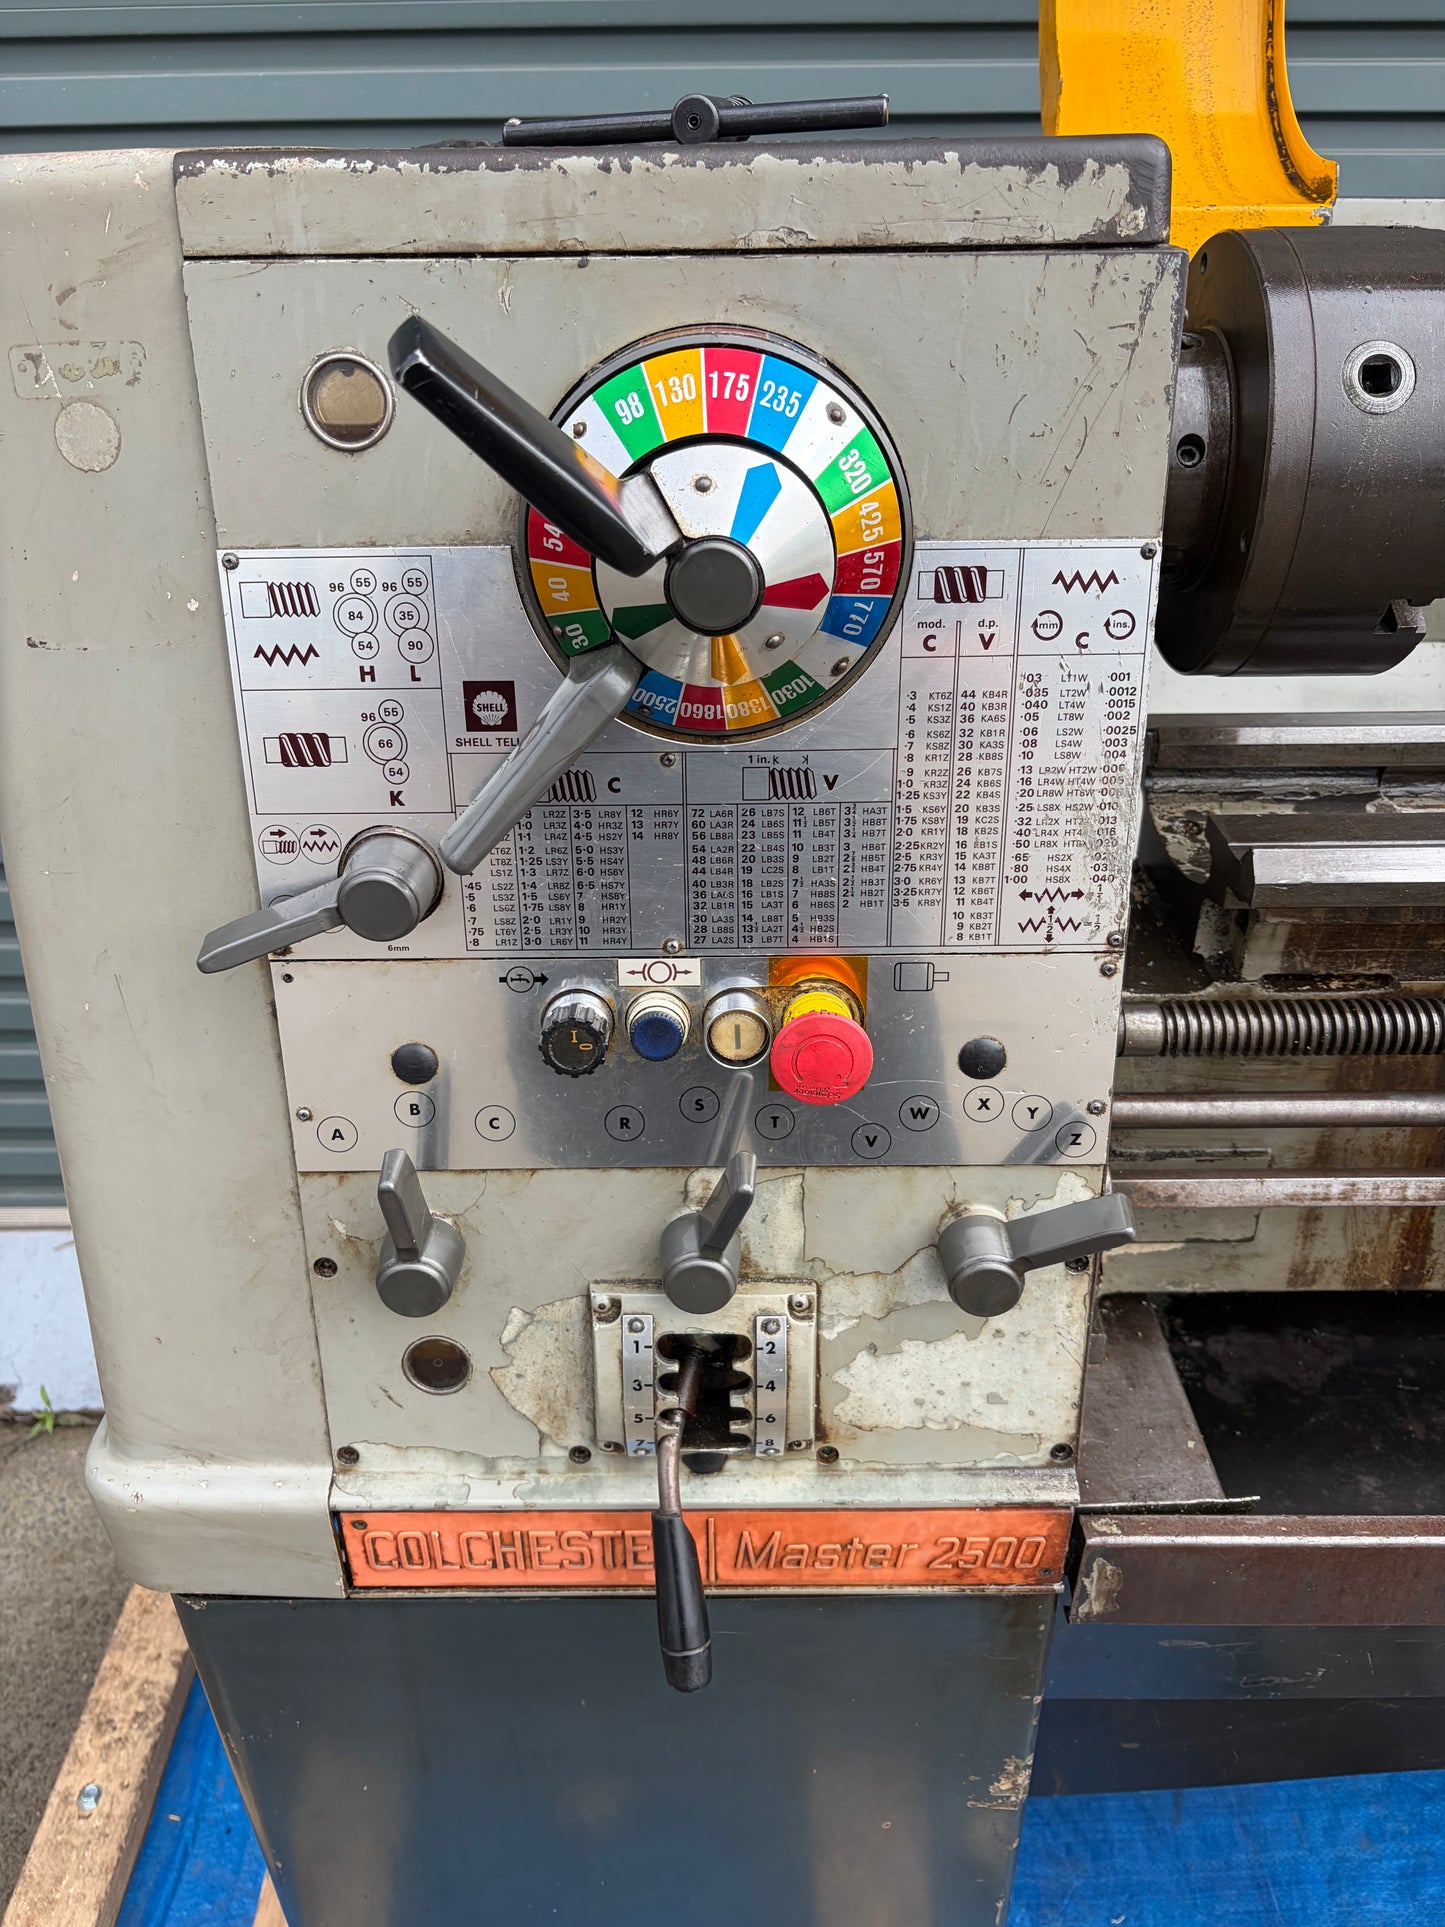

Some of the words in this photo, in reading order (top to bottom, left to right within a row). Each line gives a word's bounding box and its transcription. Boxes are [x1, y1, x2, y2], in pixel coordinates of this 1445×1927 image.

[654, 374, 695, 406] 130
[708, 371, 750, 401] 175
[759, 381, 802, 417] 235
[614, 392, 644, 424] 98
[838, 450, 872, 494] 320
[860, 501, 884, 543] 425
[860, 552, 884, 590] 570
[356, 578, 371, 586] 55
[407, 578, 422, 586] 55
[329, 583, 344, 592] 96
[382, 582, 397, 592] 96
[547, 577, 568, 601] 40
[348, 611, 364, 620] 84
[399, 611, 414, 620] 35
[844, 600, 874, 636] 770
[917, 619, 946, 629] mod.
[978, 619, 999, 629] d.p.
[565, 623, 588, 649] 30
[1076, 632, 1089, 649] C
[358, 641, 373, 650] 54
[408, 641, 423, 650] 90
[923, 634, 936, 651] C
[979, 633, 995, 650] V
[360, 666, 376, 682] H
[411, 666, 421, 682] L
[773, 674, 816, 704] 1030
[961, 690, 976, 699] 44
[982, 691, 1008, 699] KB4R
[632, 689, 677, 711] 2500
[477, 703, 505, 712] SHELL
[681, 700, 723, 720] 1860
[728, 698, 770, 719] 1380
[960, 702, 976, 711] 40
[981, 703, 1007, 711] KB3R
[384, 708, 398, 716] 55
[361, 712, 376, 722] 96
[959, 729, 974, 737] 32
[980, 729, 1005, 737] KB1R
[378, 739, 393, 748] 66
[456, 737, 492, 747] SHELL
[748, 755, 753, 763] 1
[757, 755, 770, 763] in.
[958, 753, 973, 761] 28
[978, 752, 1003, 760] KB8S
[389, 768, 404, 777] 54
[924, 768, 949, 776] KR2Z
[957, 767, 972, 776] 26
[977, 768, 1003, 776] KB7S
[608, 777, 621, 793] C
[823, 774, 839, 790] V
[390, 791, 405, 807] K
[742, 808, 756, 816] 26
[762, 809, 784, 817] LB7S
[863, 807, 888, 815] HA3T
[955, 804, 969, 812] 20
[976, 804, 1000, 812] KB3S
[654, 810, 679, 818] HR6Y
[692, 809, 705, 817] 72
[710, 810, 733, 818] LA6R
[742, 820, 756, 828] 24
[762, 820, 784, 828] LB6S
[863, 818, 887, 826] HB8T
[922, 817, 946, 825] KS8Y
[957, 816, 969, 824] 19
[975, 816, 1000, 824] KC2S
[632, 821, 643, 829] 13
[654, 821, 679, 829] HR7Y
[692, 821, 705, 829] 60
[710, 821, 733, 829] LA3R
[633, 832, 644, 840] 14
[813, 830, 835, 838] LB4T
[545, 847, 568, 855] LR6Z
[742, 844, 755, 852] 22
[761, 844, 784, 852] LB4S
[792, 843, 803, 851] 10
[813, 844, 835, 852] LB3T
[844, 843, 849, 851] 3
[861, 843, 886, 851] HB6T
[742, 855, 755, 863] 20
[1047, 854, 1072, 862] HS2X
[492, 883, 514, 891] LS2Z
[601, 882, 625, 890] HS7Y
[692, 880, 706, 888] 40
[711, 880, 734, 888] LB3R
[742, 901, 753, 909] 15
[761, 901, 784, 909] LA3T
[843, 900, 849, 908] 2
[860, 900, 884, 908] HB1T
[580, 937, 588, 945] 11
[603, 937, 627, 945] HR4Y
[694, 936, 706, 944] 27
[712, 936, 734, 944] LA2S
[956, 933, 963, 941] 8
[969, 933, 992, 941] KB1T
[693, 1097, 704, 1113] S
[978, 1096, 990, 1111] X
[409, 1103, 421, 1117] B
[908, 1107, 930, 1120] W
[1026, 1107, 1039, 1121] Y
[488, 1116, 500, 1131] C
[619, 1117, 631, 1131] R
[769, 1115, 781, 1129] T
[330, 1129, 344, 1141] A
[864, 1135, 878, 1148] V
[1070, 1133, 1081, 1147] Z
[633, 1341, 639, 1353] 1
[766, 1342, 775, 1354] 2
[633, 1380, 642, 1391] 3
[765, 1380, 776, 1391] 4
[634, 1414, 643, 1423] 5
[766, 1414, 775, 1422] 6
[361, 1529, 655, 1573] COLCHESTE
[734, 1529, 919, 1571] Master
[931, 1535, 1046, 1570] 2500
